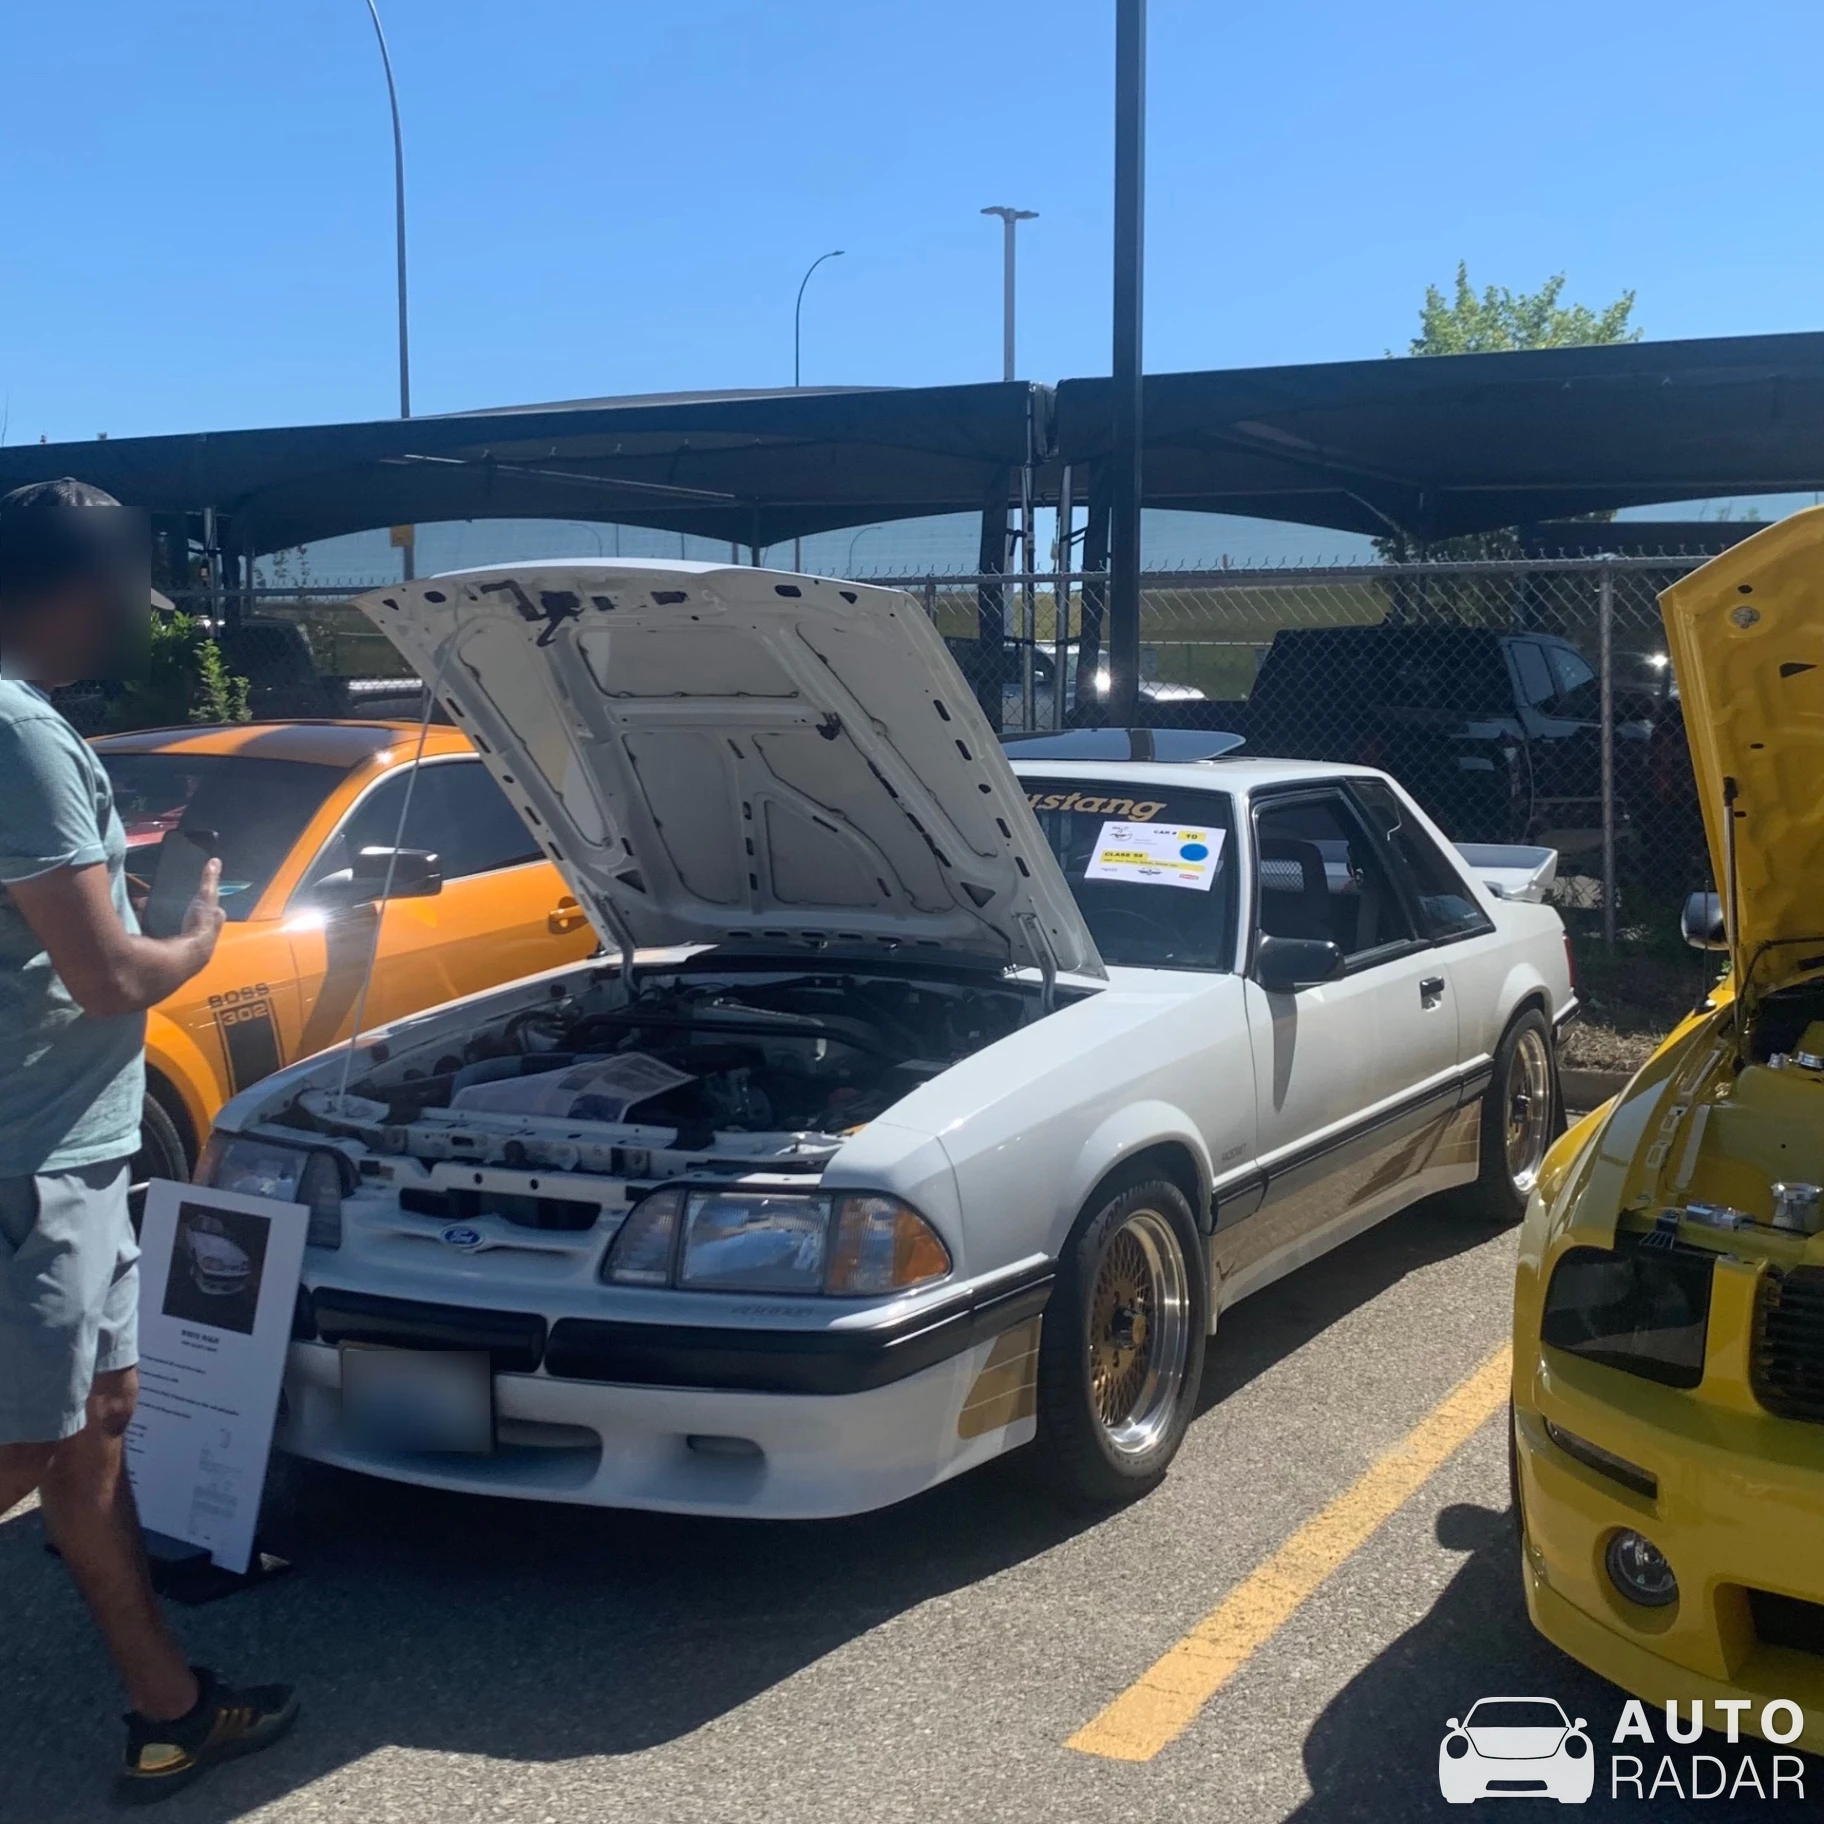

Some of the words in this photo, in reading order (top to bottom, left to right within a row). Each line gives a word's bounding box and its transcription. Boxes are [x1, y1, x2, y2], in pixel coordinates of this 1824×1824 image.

[1025, 792, 1167, 822] ustang
[208, 983, 269, 1008] BOSS
[222, 1002, 268, 1026] 302
